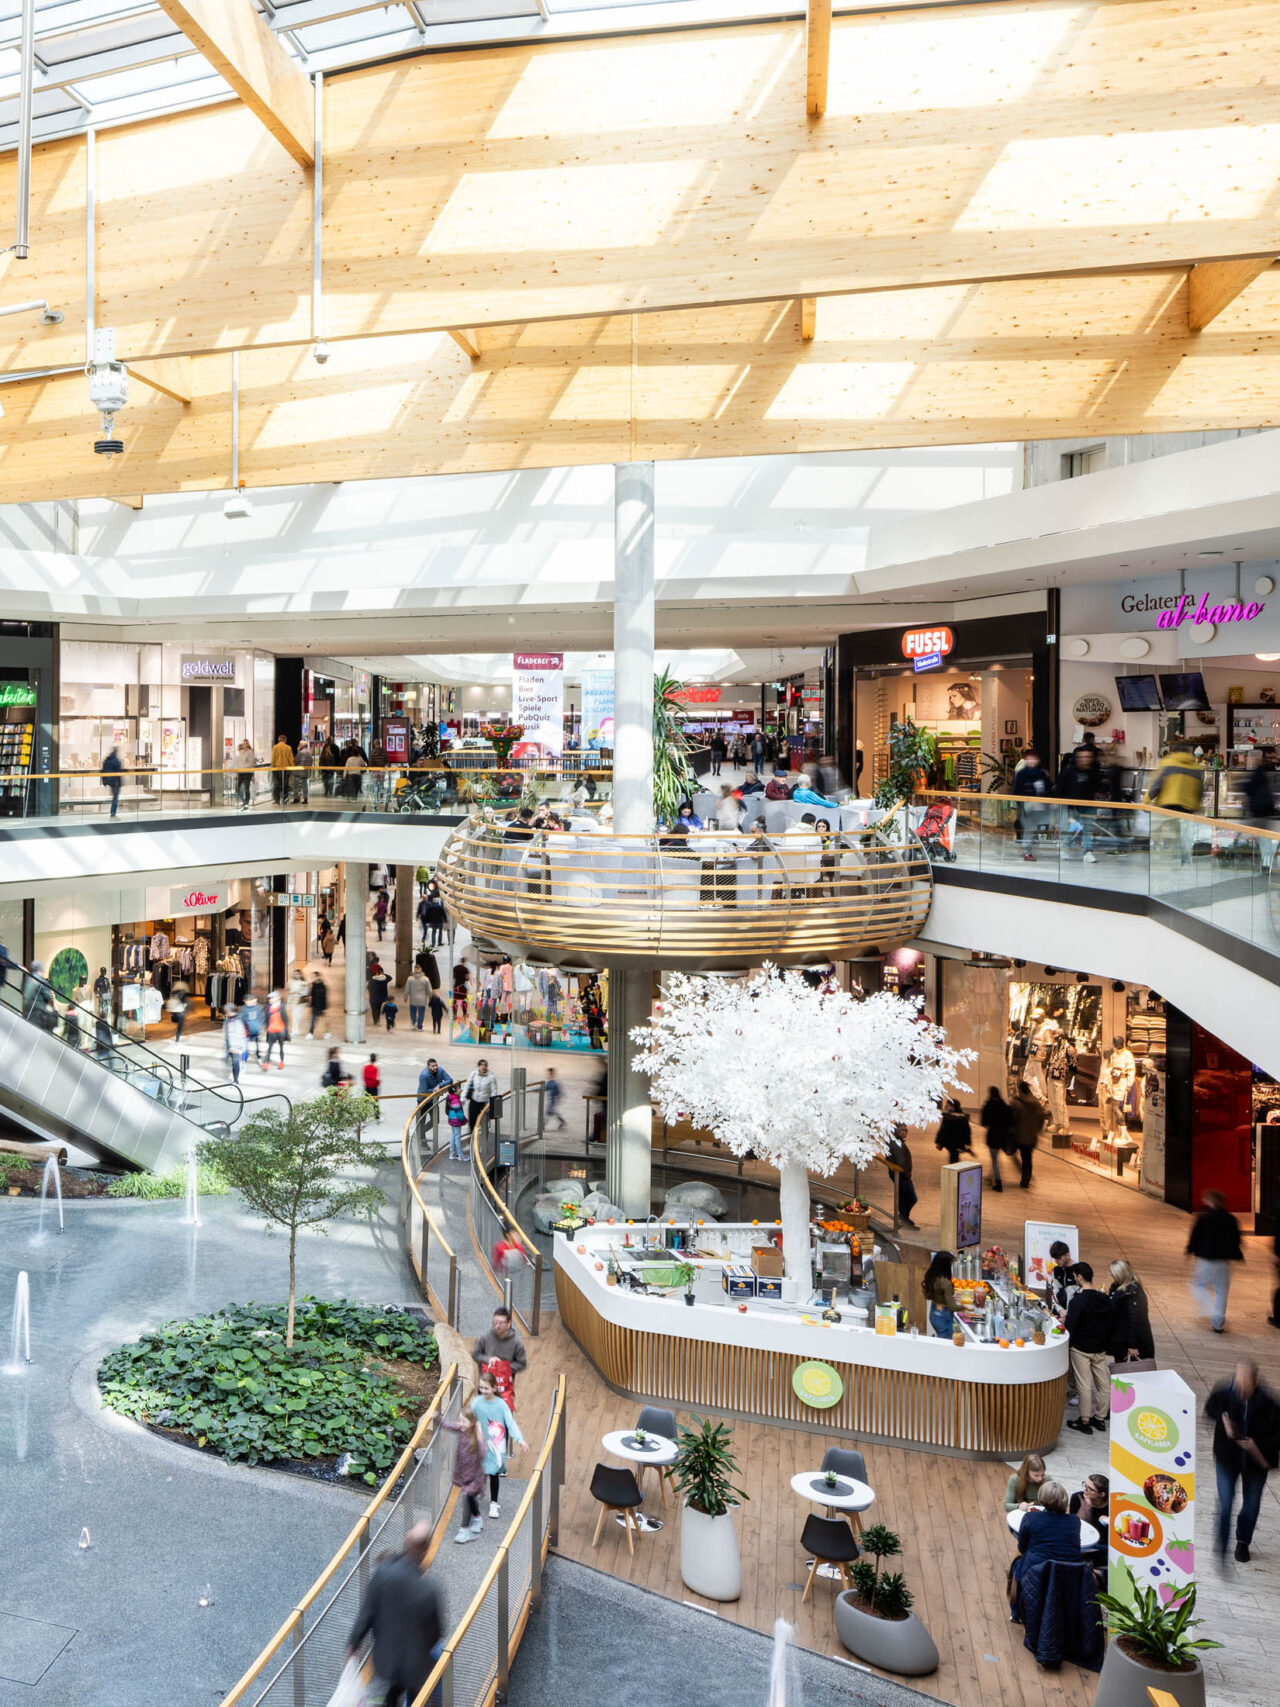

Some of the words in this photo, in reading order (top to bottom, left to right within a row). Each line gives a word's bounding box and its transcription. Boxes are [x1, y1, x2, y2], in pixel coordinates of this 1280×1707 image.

[1156, 592, 1266, 629] al-bano
[906, 631, 949, 654] FUSSL
[183, 660, 235, 679] goldwelt
[519, 695, 558, 703] Live-Sport
[519, 704, 542, 712] Spiele
[519, 714, 551, 722] PubQuiz
[184, 891, 219, 908] s.Oliver
